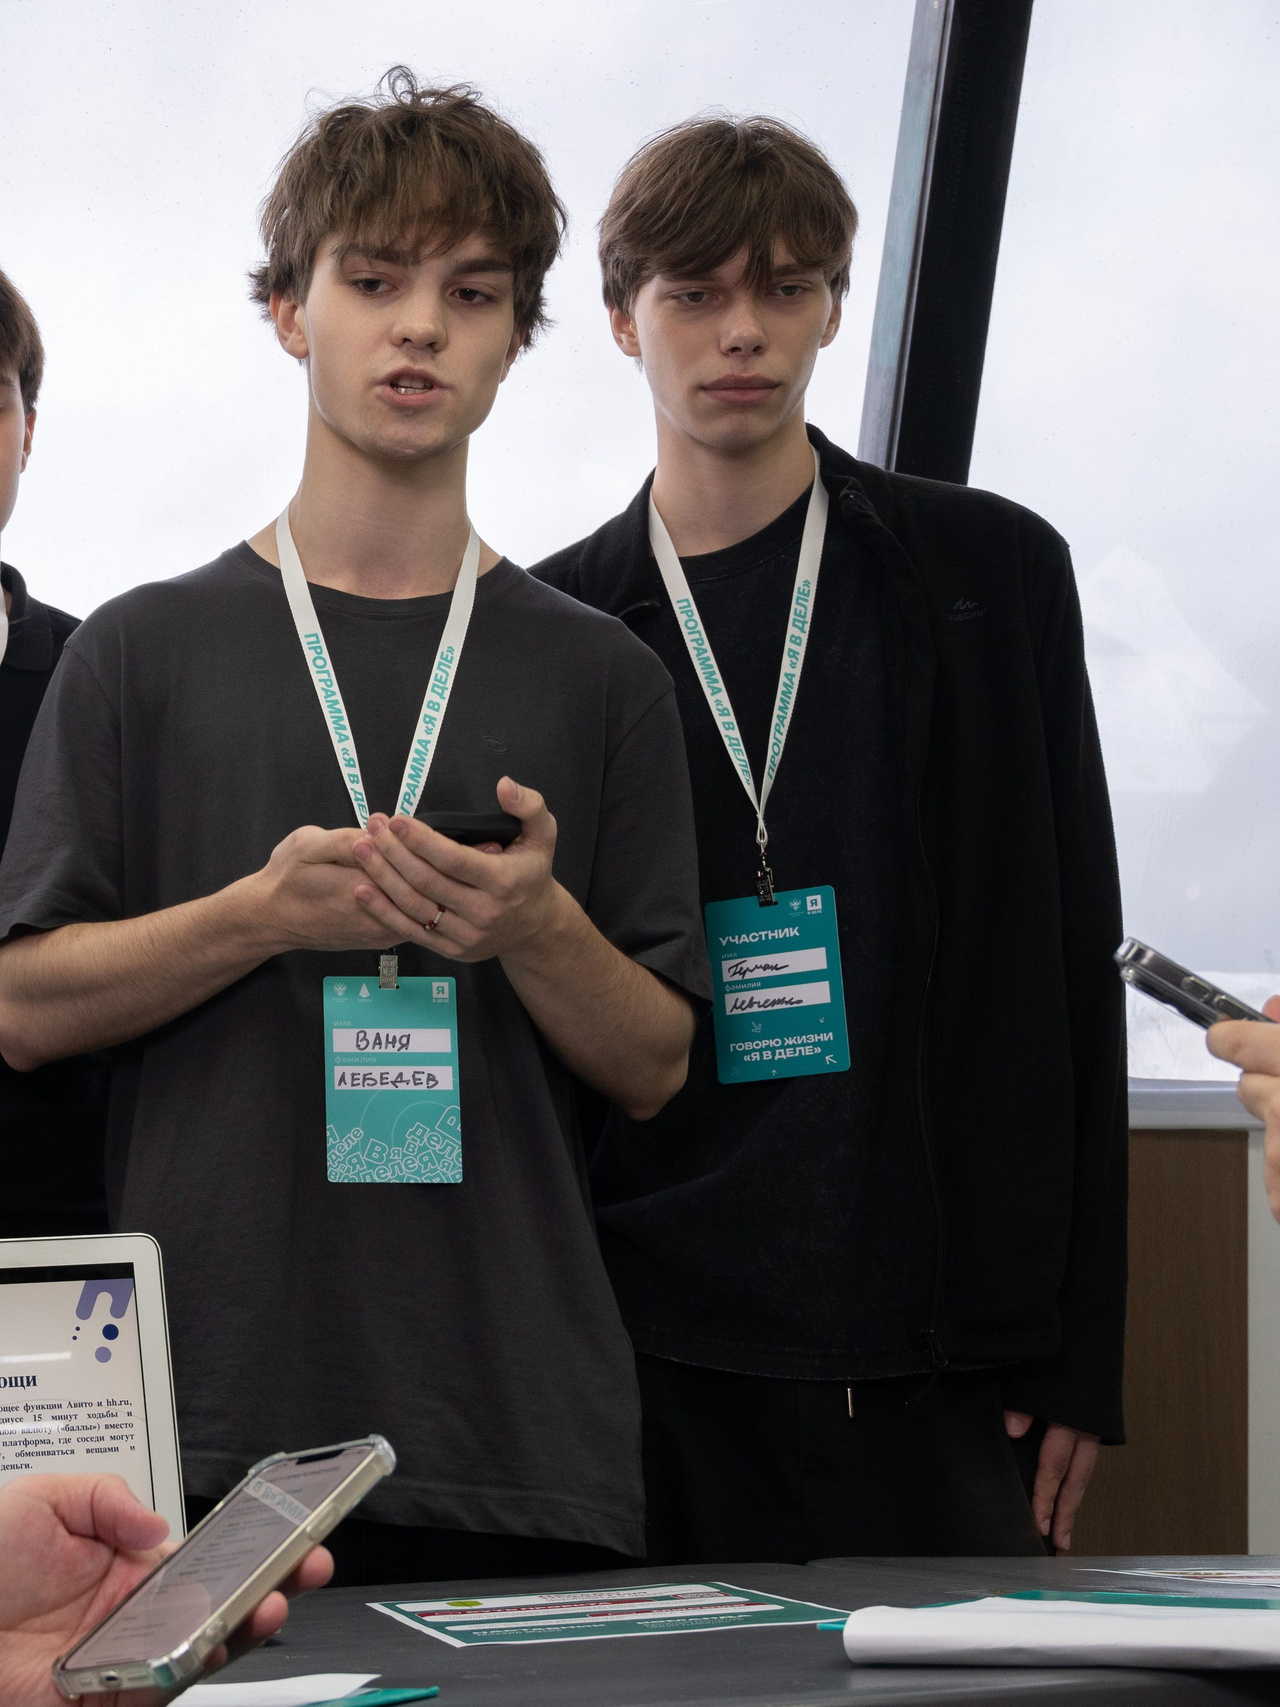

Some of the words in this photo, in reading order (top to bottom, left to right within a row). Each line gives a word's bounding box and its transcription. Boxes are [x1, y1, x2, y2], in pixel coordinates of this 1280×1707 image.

[792, 579, 811, 634] ДЕЛЕ»
[676, 598, 722, 696] ПРОГРАММА
[790, 634, 802, 647] В
[788, 648, 800, 670] «Я
[431, 645, 455, 700] ДЕЛЕ»
[304, 632, 350, 744] ПРОГРАММА
[427, 700, 441, 712] В
[714, 698, 731, 717] «Я
[424, 715, 437, 736] «Я
[721, 721, 735, 731] В
[766, 672, 795, 780] ПРОГРАММА
[341, 747, 356, 768] «Я
[725, 734, 751, 786] ДЕЛЕ»
[347, 773, 360, 785] В
[399, 738, 431, 816] ГРАММА
[719, 926, 800, 946] УЧАСТНИК
[724, 980, 762, 992] фамилия
[355, 1030, 411, 1051] ВАНЯ
[729, 1037, 782, 1052] ГОВОРЮ
[784, 1032, 834, 1046] ЖИЗНИ
[334, 1055, 377, 1064] фамилия
[743, 1049, 760, 1062] «Я
[762, 1049, 773, 1060] В
[774, 1046, 822, 1060] ДЕЛЕ»
[337, 1071, 439, 1089] ЛЕБЕДЕВ
[23, 1403, 63, 1413] функции
[66, 1400, 94, 1409] Авито
[106, 1399, 133, 1407] hh.ru,
[33, 1414, 43, 1422] 15
[51, 1414, 79, 1422] минут
[86, 1410, 118, 1419] ходьбы
[21, 1426, 52, 1435] валюту
[57, 1423, 101, 1433] («баллы»)
[2, 1438, 54, 1448] платформа,
[76, 1435, 105, 1443] соседи
[109, 1433, 135, 1442] могут
[15, 1448, 75, 1458] обмениваться
[85, 1445, 120, 1455] вещами
[0, 1462, 34, 1471] деньги.
